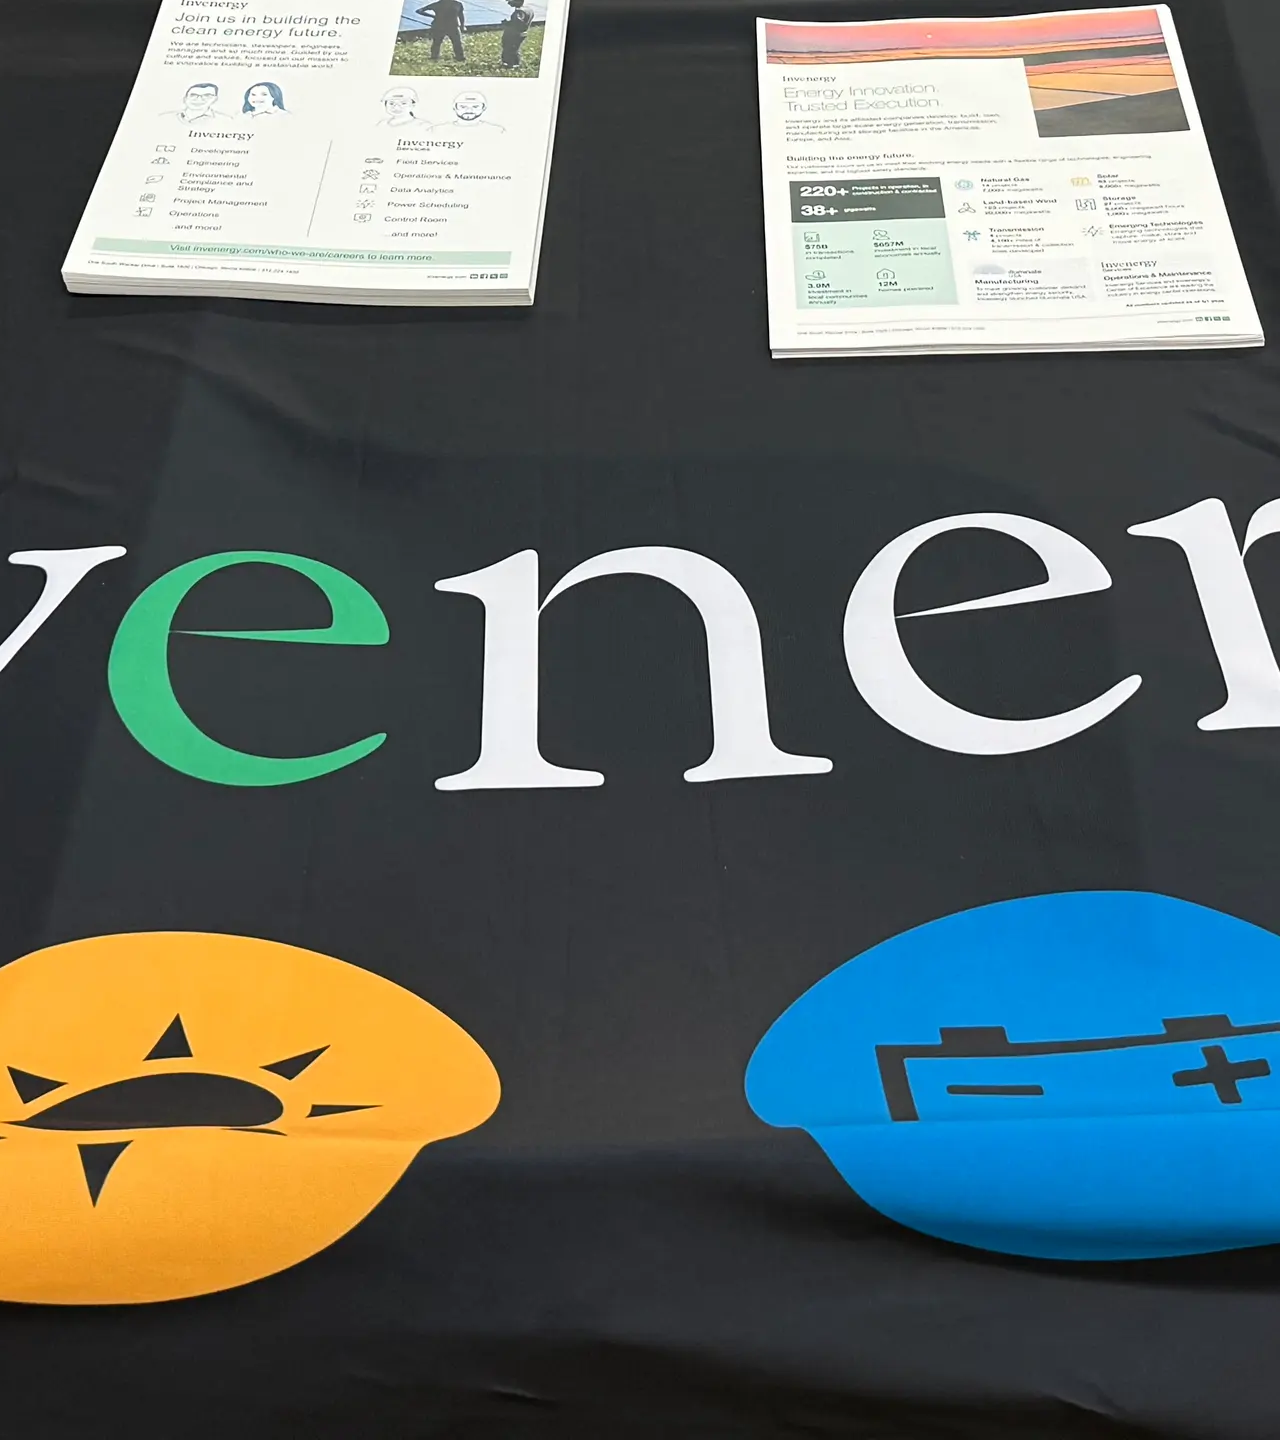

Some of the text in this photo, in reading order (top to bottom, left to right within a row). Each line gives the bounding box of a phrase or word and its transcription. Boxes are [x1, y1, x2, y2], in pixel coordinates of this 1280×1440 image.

[174, 12, 361, 27] Join us in building the
[171, 25, 342, 39] clean energy future.
[783, 84, 940, 99] Energy Innovation.
[783, 97, 943, 112] Trusted Execution.
[188, 130, 255, 141] Invenergy
[397, 139, 464, 149] Invenergy
[190, 147, 250, 155] Development
[179, 178, 233, 186] Compliance
[177, 185, 216, 193] Strategy
[799, 185, 849, 197] 220+
[173, 197, 268, 207] Project Management
[168, 210, 220, 218] Operations
[800, 205, 839, 216] 38+
[384, 215, 418, 223] Control
